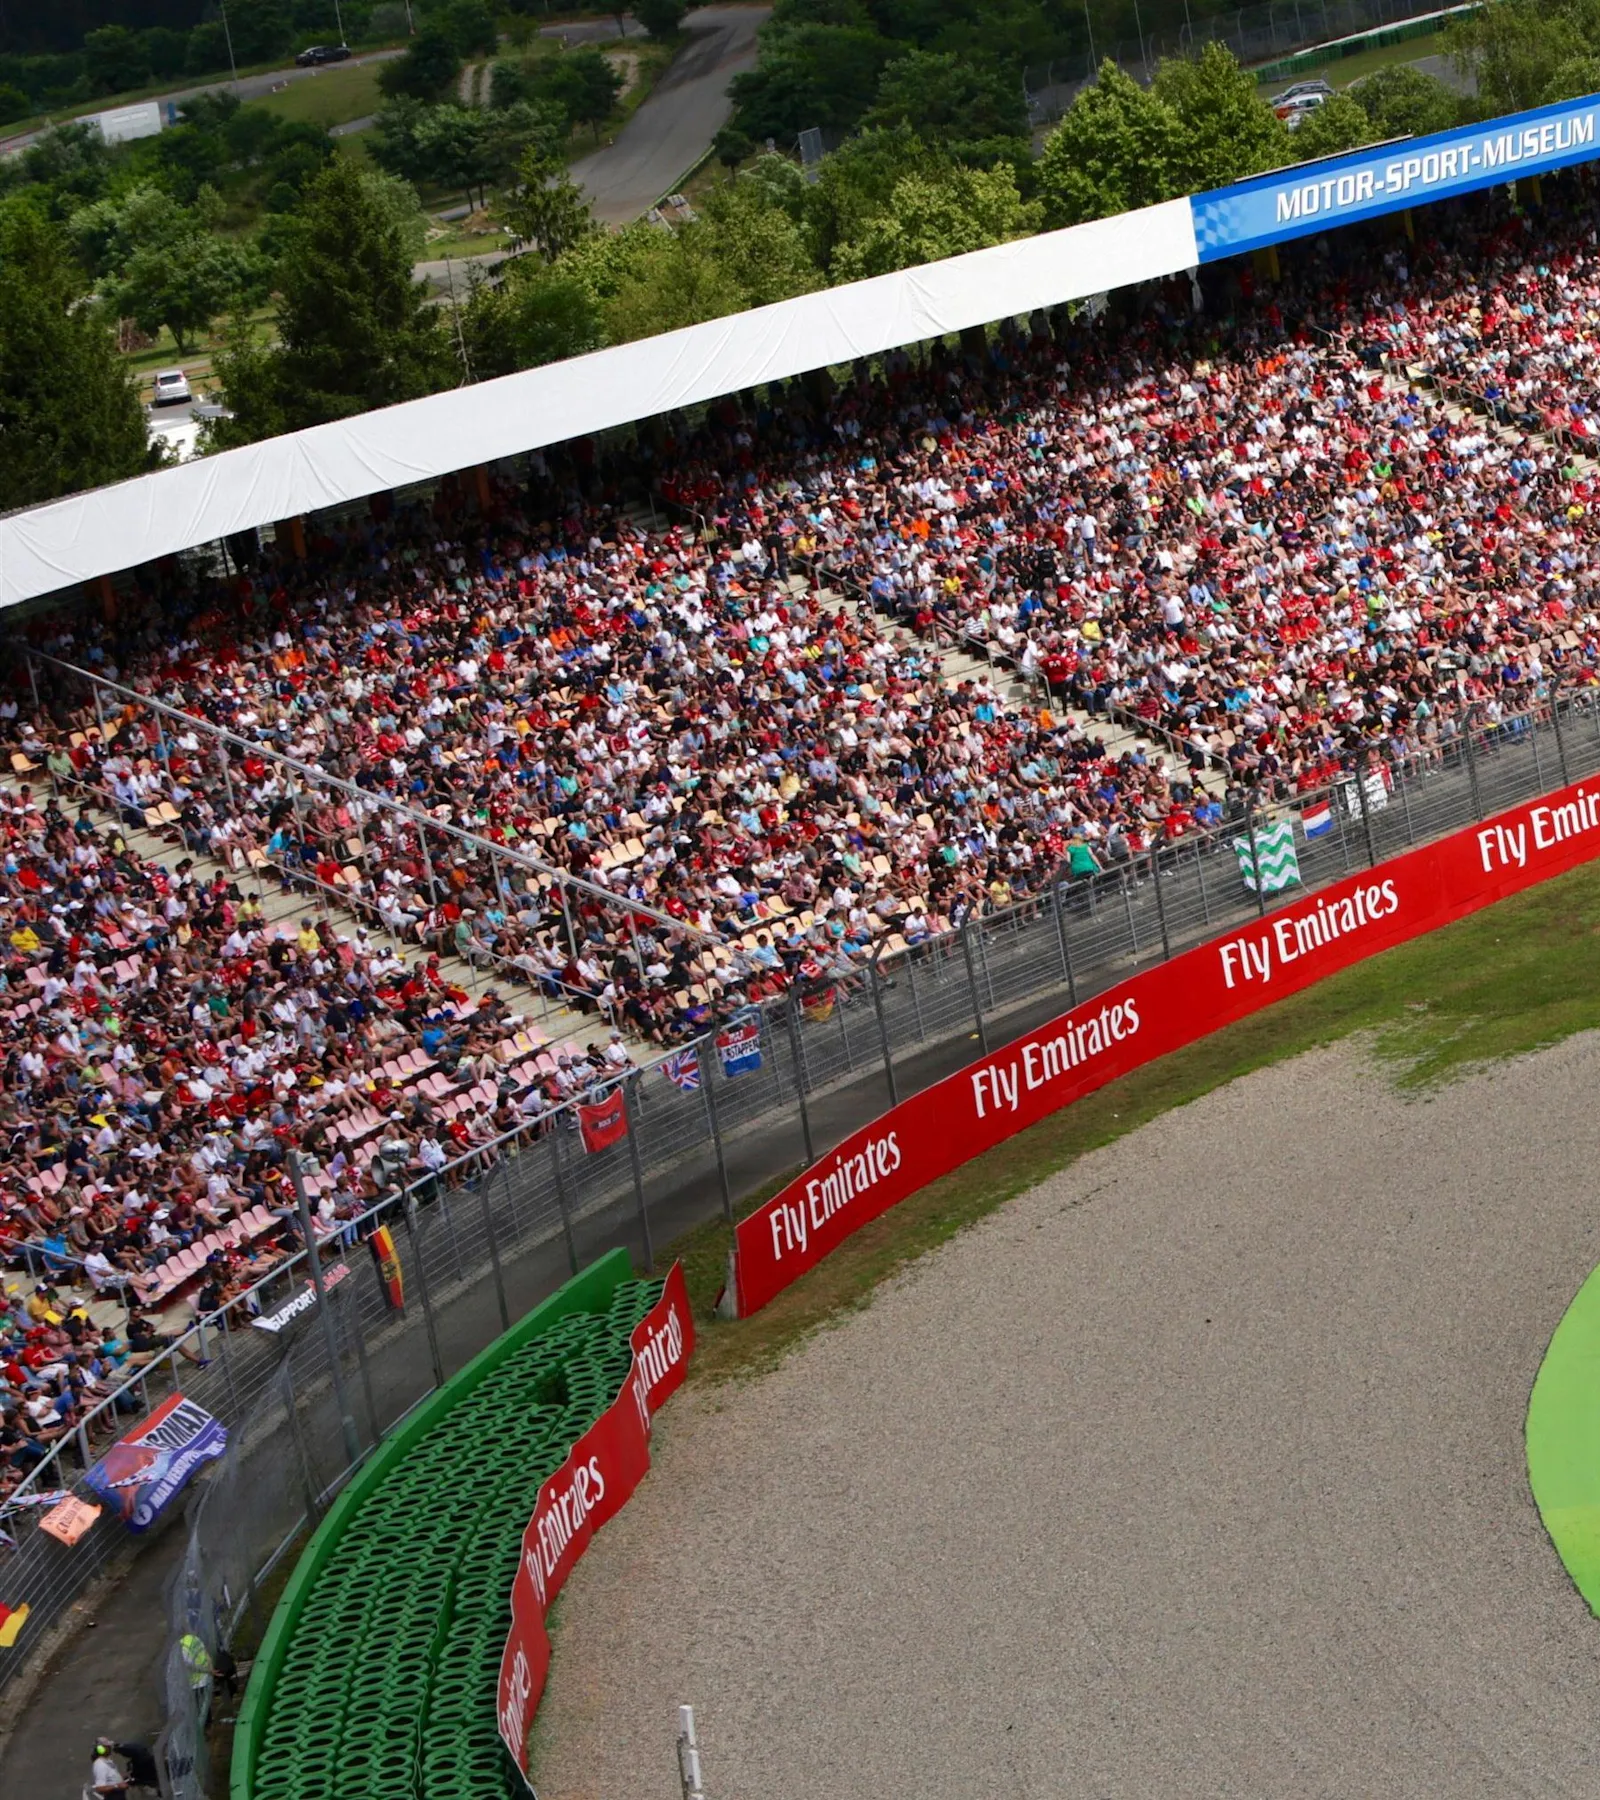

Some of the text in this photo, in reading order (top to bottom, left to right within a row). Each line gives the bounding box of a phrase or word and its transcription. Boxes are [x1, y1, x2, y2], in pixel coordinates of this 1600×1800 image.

[1277, 114, 1594, 222] MOTOR-SPORT-MUSEUM
[1477, 824, 1526, 873] Fly
[1219, 880, 1399, 989] Fly Emirates
[971, 998, 1140, 1119] Fly Emirates
[770, 1132, 901, 1261] Fly Emirates
[269, 1288, 317, 1331] SUPPORT
